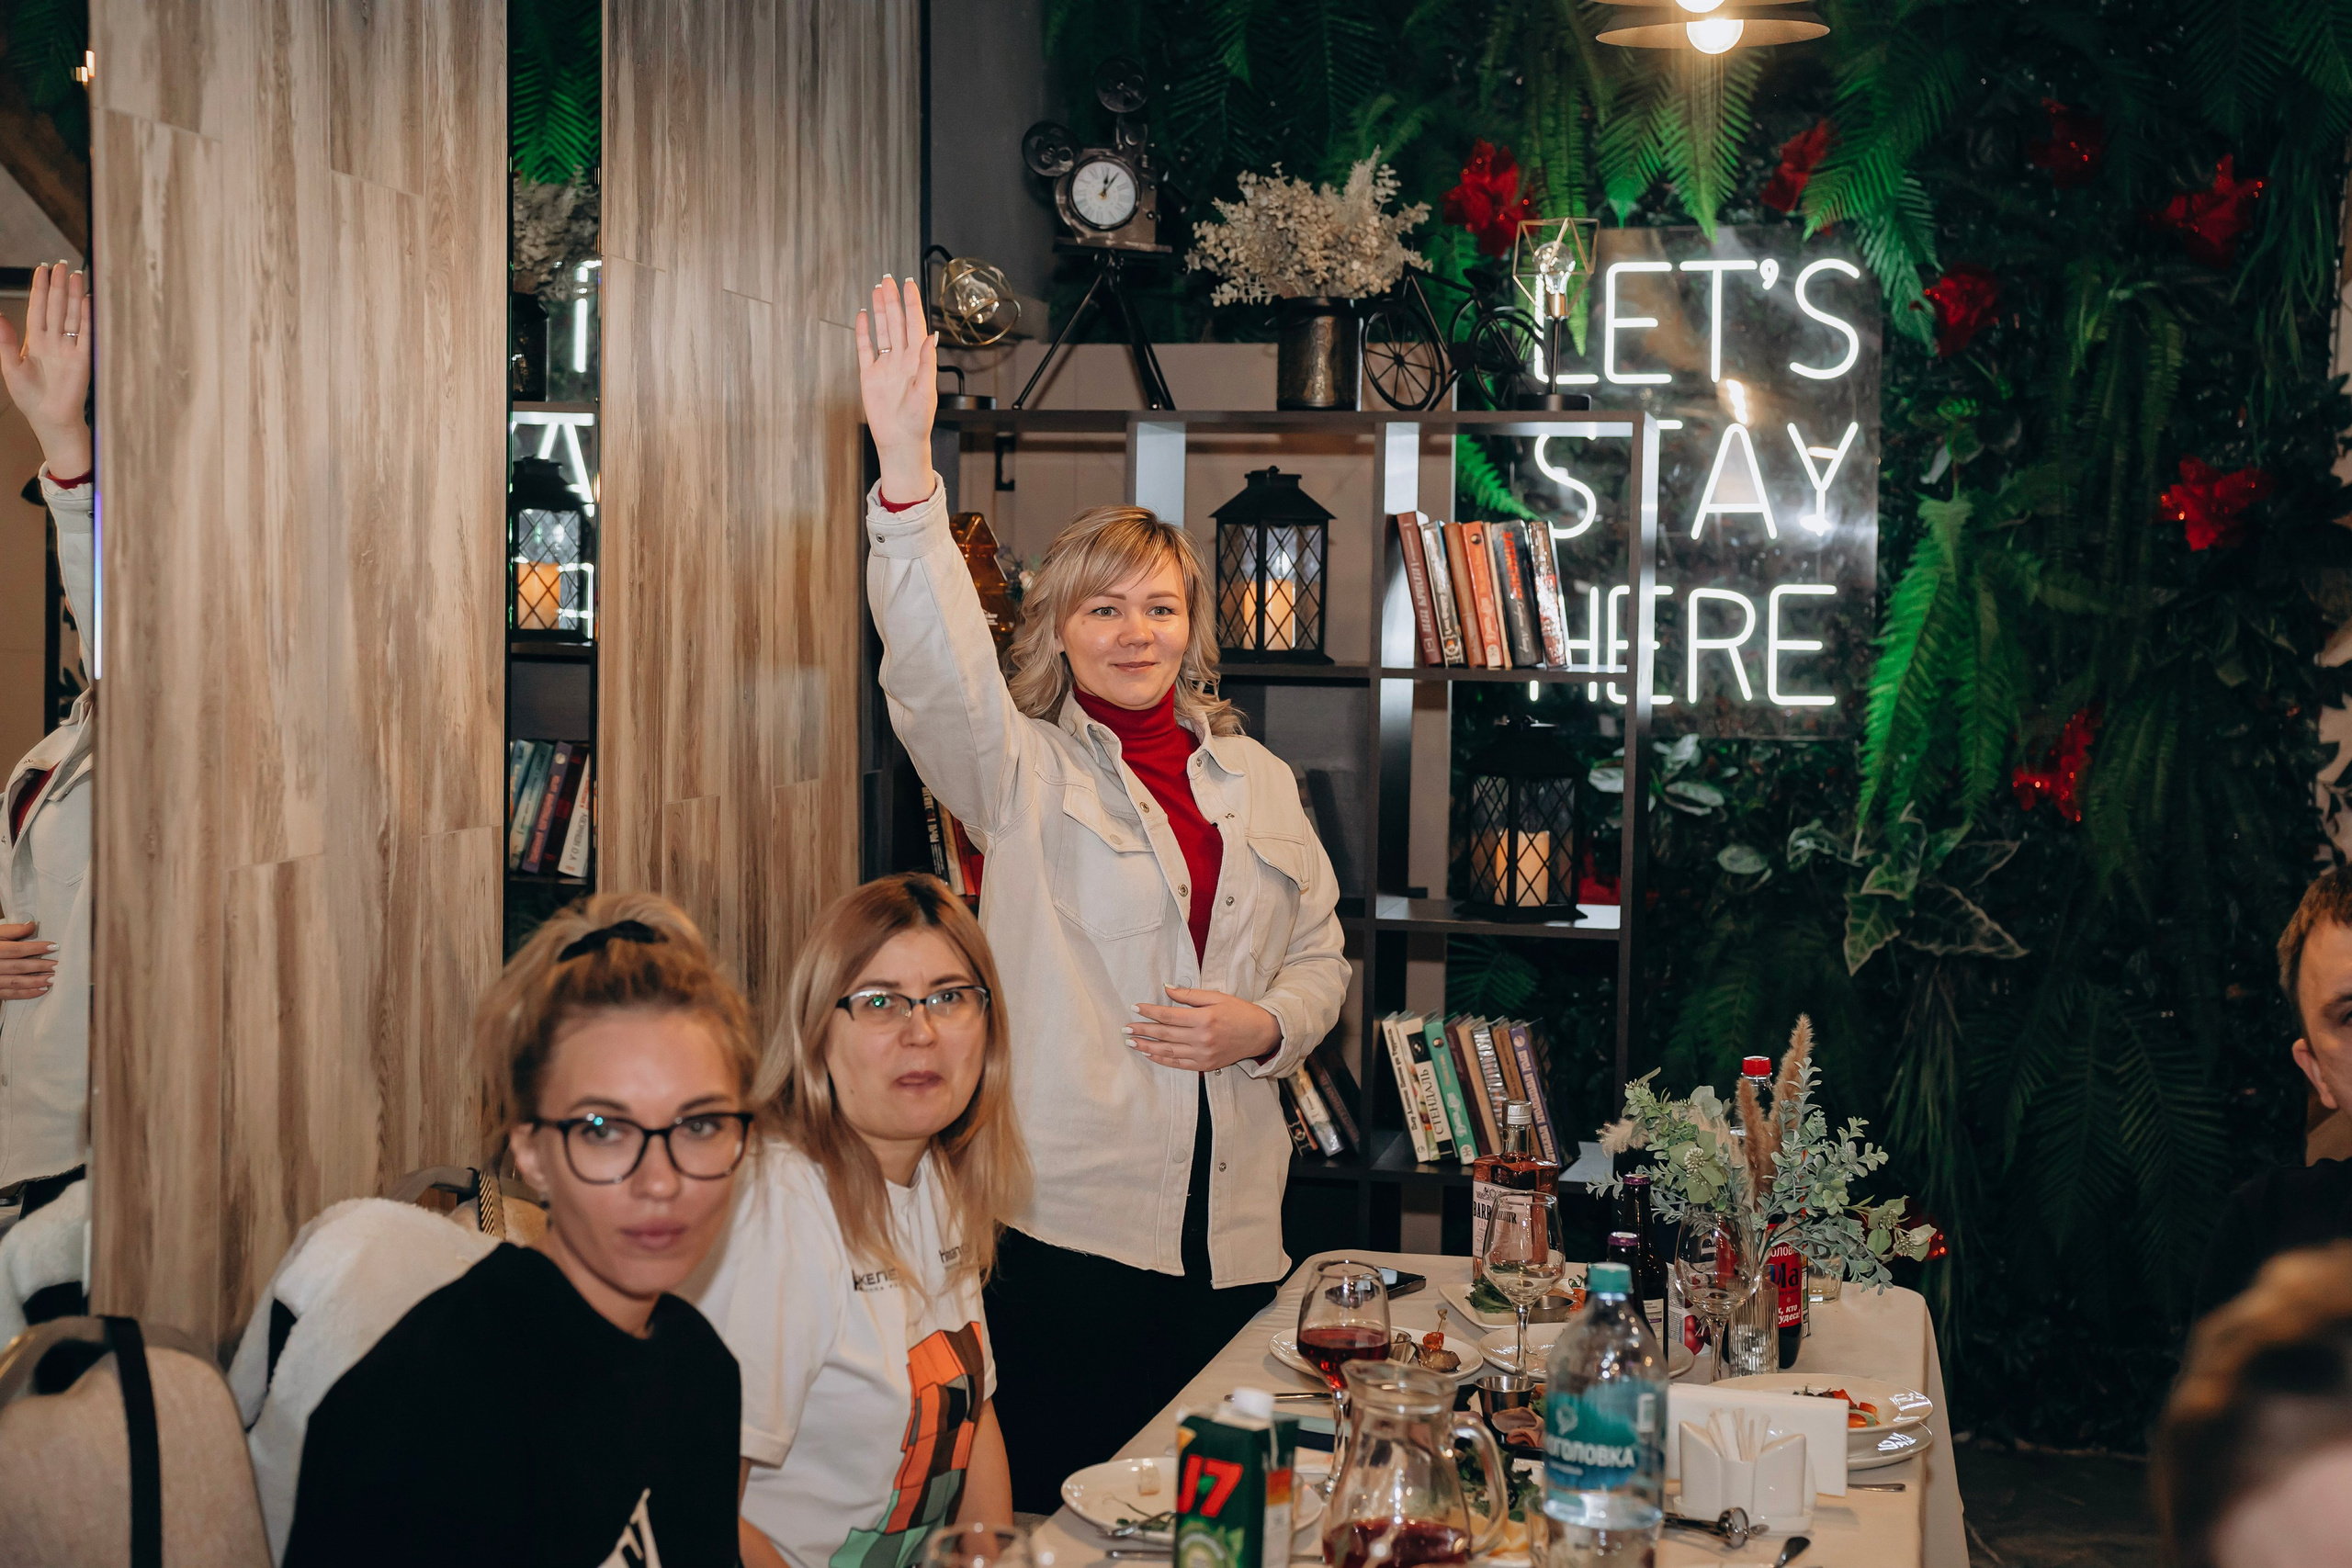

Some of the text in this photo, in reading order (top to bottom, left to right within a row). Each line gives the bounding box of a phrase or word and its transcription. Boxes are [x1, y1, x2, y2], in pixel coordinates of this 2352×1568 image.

[1533, 257, 1861, 383] LET'S
[1419, 1068, 1444, 1134] СТЕНДАЛЬ
[1778, 1308, 1801, 1325] удеса!
[1176, 1453, 1244, 1518] J7
